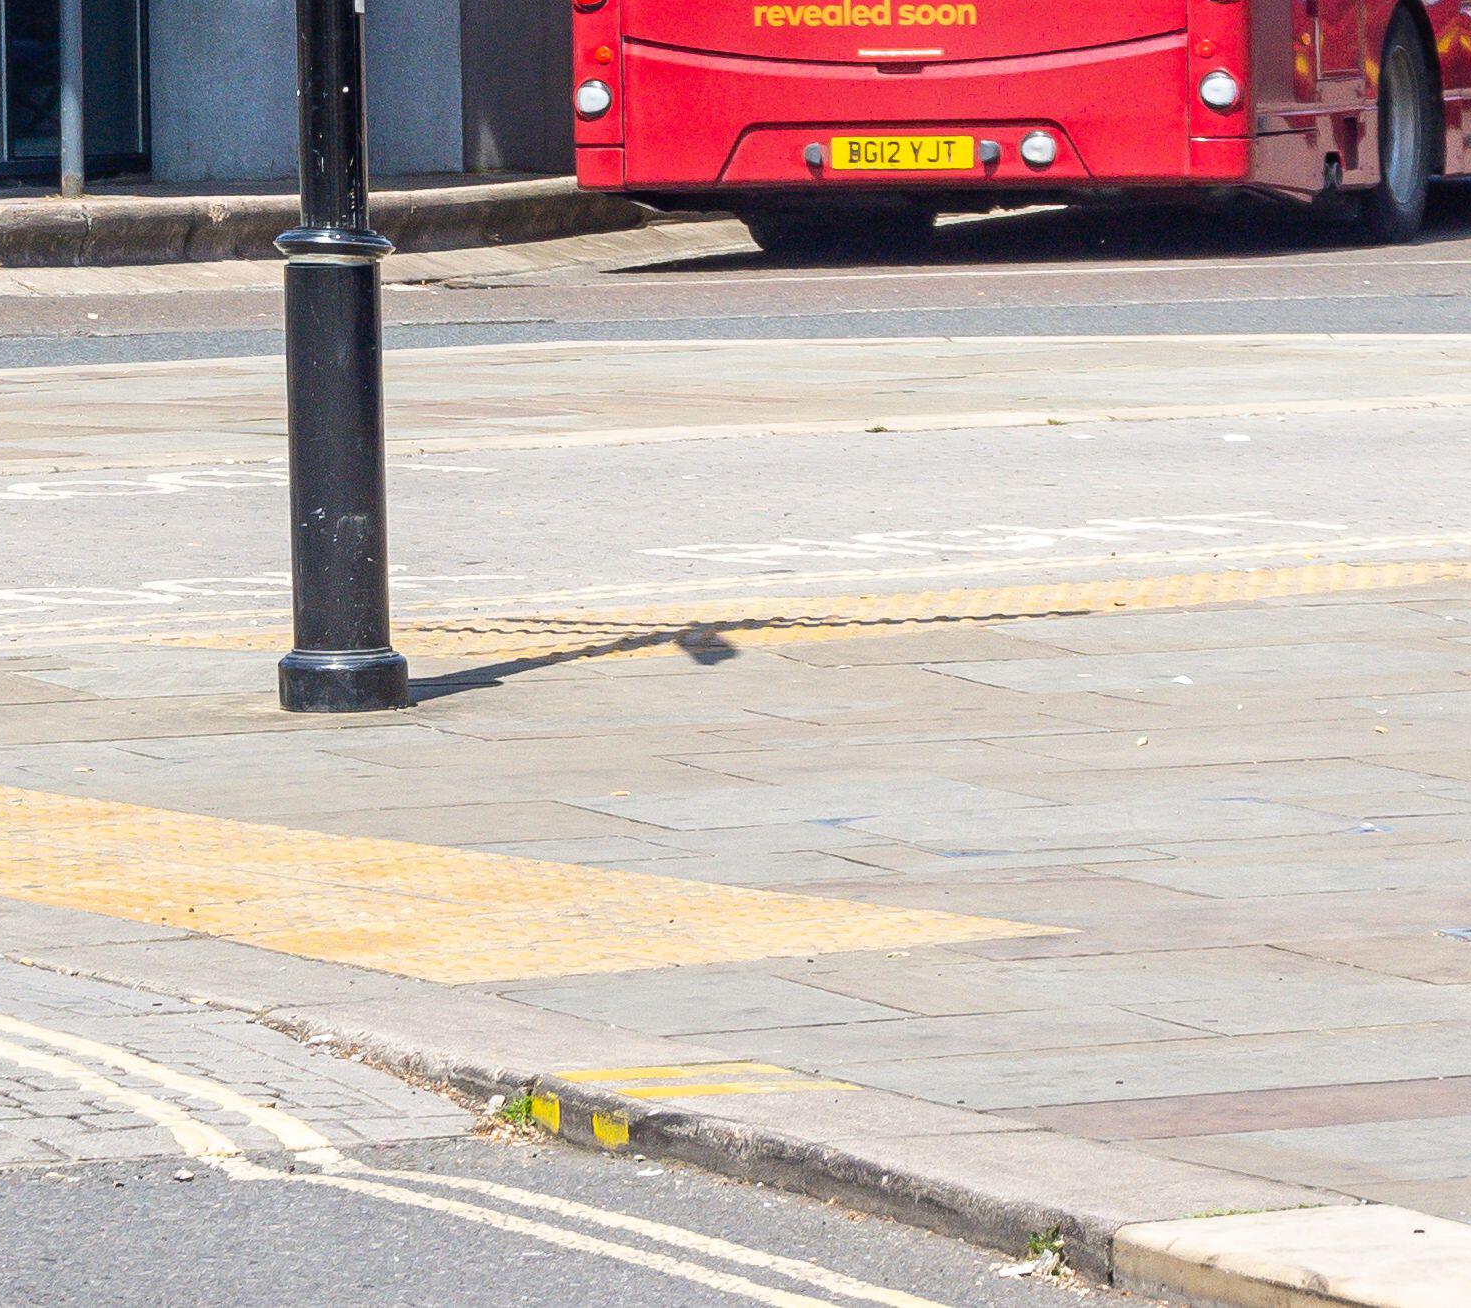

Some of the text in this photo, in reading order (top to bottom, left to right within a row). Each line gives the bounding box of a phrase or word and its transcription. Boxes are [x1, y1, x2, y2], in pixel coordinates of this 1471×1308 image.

[849, 141, 956, 163] BG12 YJT
[634, 511, 1347, 565] RIGHT
